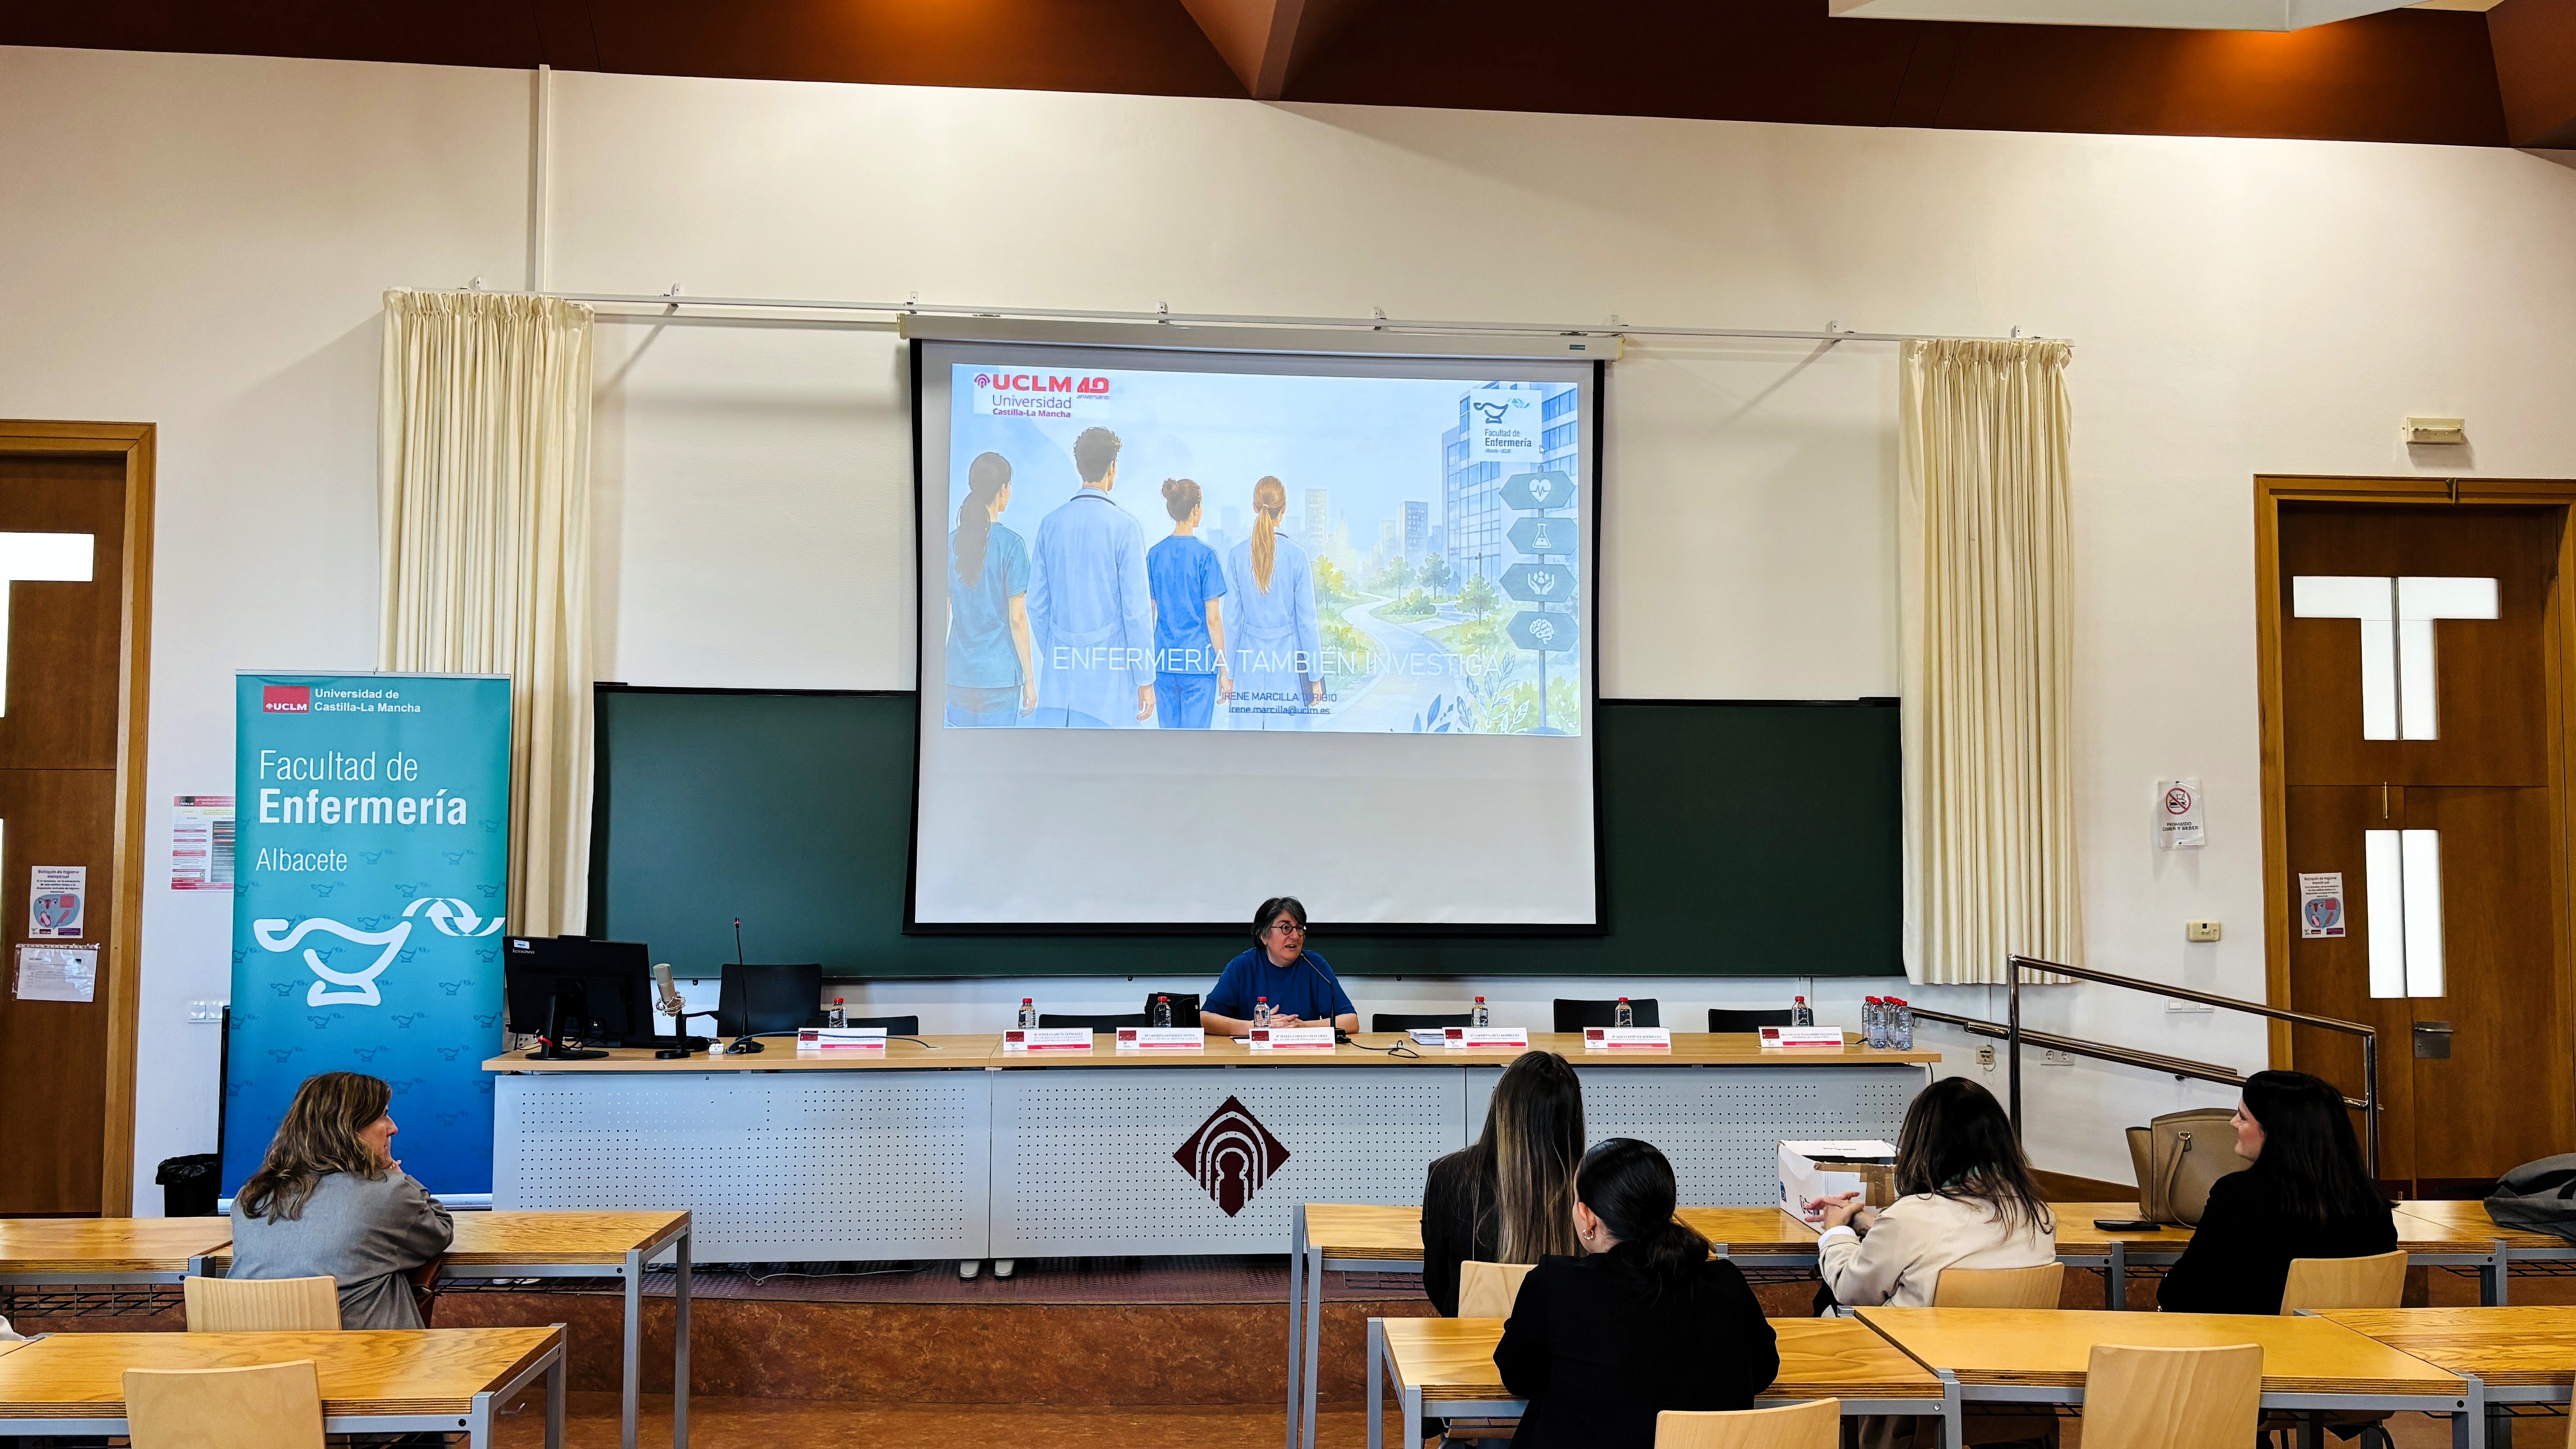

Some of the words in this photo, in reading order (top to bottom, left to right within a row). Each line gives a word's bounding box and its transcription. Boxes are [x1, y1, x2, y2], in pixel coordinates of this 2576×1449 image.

[993, 374, 1071, 392] UCLM
[993, 395, 1071, 409] Universidad
[993, 408, 1036, 416] Castilla-La
[1485, 429, 1510, 437] Facultad
[1485, 438, 1532, 447] Enfermería
[1053, 644, 1229, 672] ENFERMERÍA
[1237, 645, 1355, 674] TAMBIÉN
[1366, 652, 1502, 676] INVESTIGA
[315, 689, 382, 699] Universidad
[386, 690, 399, 699] de
[1222, 692, 1249, 700] IRENE
[1252, 693, 1299, 701] MARCILLA
[314, 702, 374, 712] Castilla-La
[378, 703, 420, 712] Mancha
[260, 750, 375, 781] Facultad
[387, 752, 418, 782] de
[259, 788, 467, 825] Enfermería
[256, 848, 347, 871] Albacete
